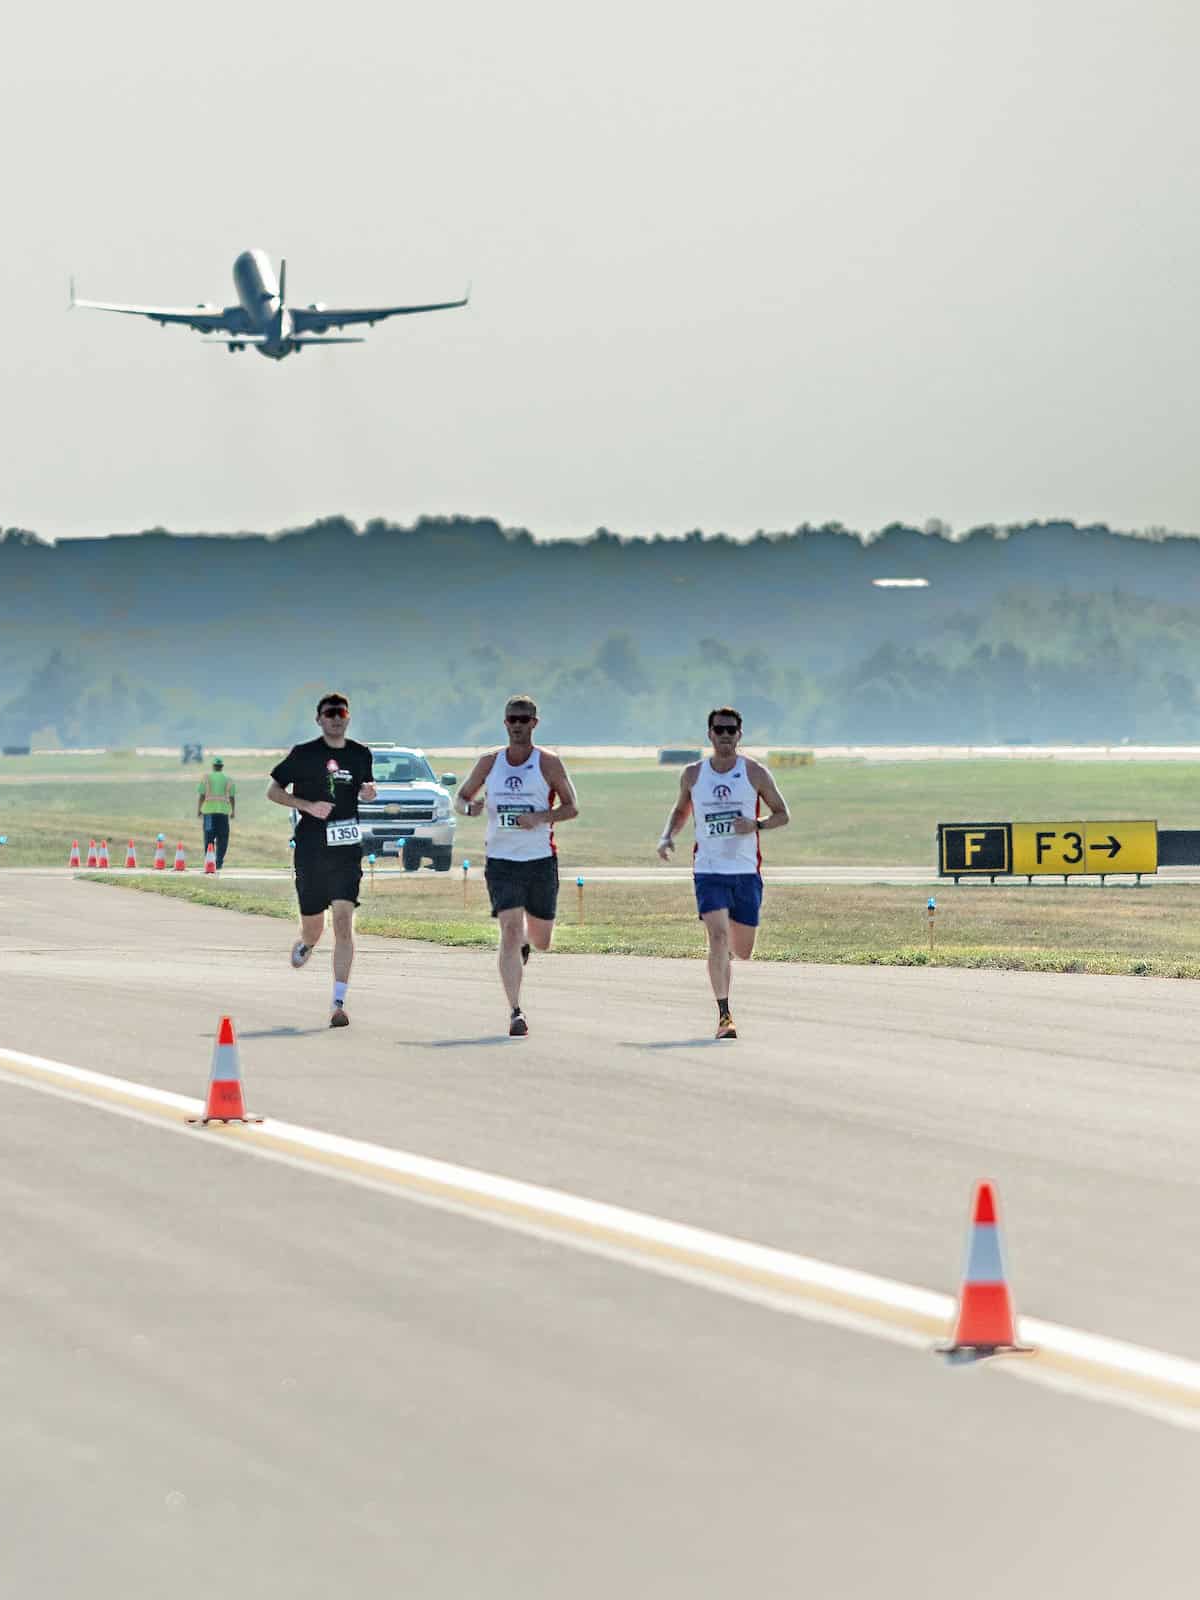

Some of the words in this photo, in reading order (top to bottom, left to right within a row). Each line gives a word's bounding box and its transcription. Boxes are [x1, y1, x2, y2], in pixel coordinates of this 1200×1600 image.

[330, 826, 359, 841] 1350
[964, 833, 986, 867] F
[1036, 831, 1084, 865] F3
